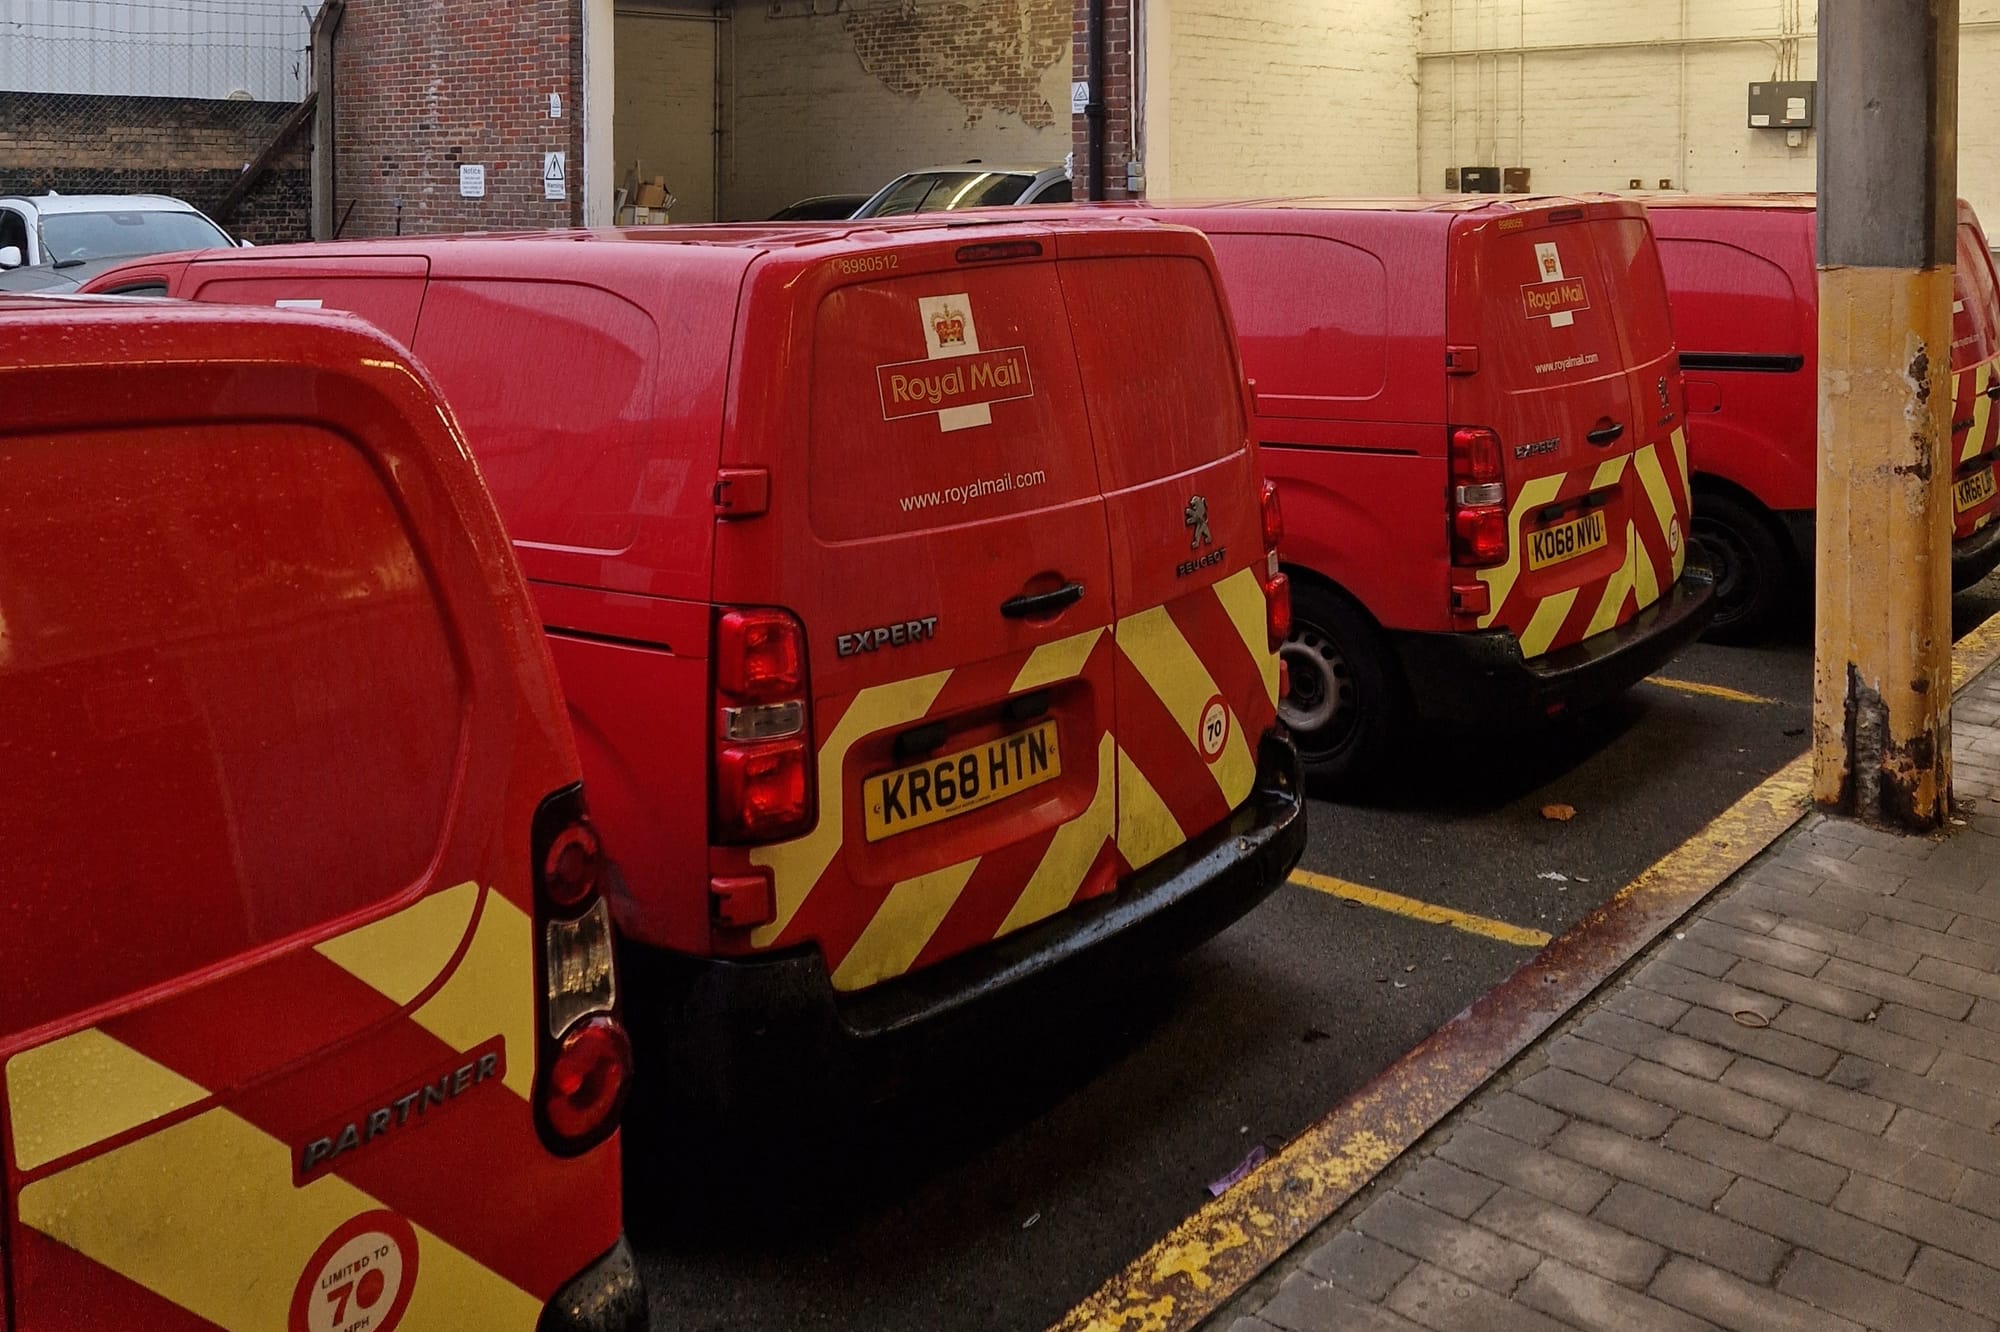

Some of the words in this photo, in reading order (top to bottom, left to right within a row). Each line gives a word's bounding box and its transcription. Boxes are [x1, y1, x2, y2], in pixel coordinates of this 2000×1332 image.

[842, 254, 898, 274] 8980512
[1528, 288, 1560, 310] Royal
[1562, 284, 1584, 304] Mail
[891, 366, 965, 404] Royal
[970, 358, 1022, 391] Mail
[1535, 353, 1599, 374] www.royalmail.com
[1514, 437, 1560, 459] EXPERT
[900, 469, 1046, 512] www.royalmail.com
[1576, 515, 1601, 549] NVU
[1177, 548, 1226, 578] PEUGEOT
[837, 616, 938, 657] EXPERT
[1207, 719, 1222, 742] 70
[881, 753, 979, 825] KR68
[987, 728, 1048, 790] HTN
[302, 1051, 497, 1173] PARTNER
[321, 1256, 370, 1289] LIMITED
[374, 1245, 389, 1260] TO
[327, 1268, 385, 1328] 70
